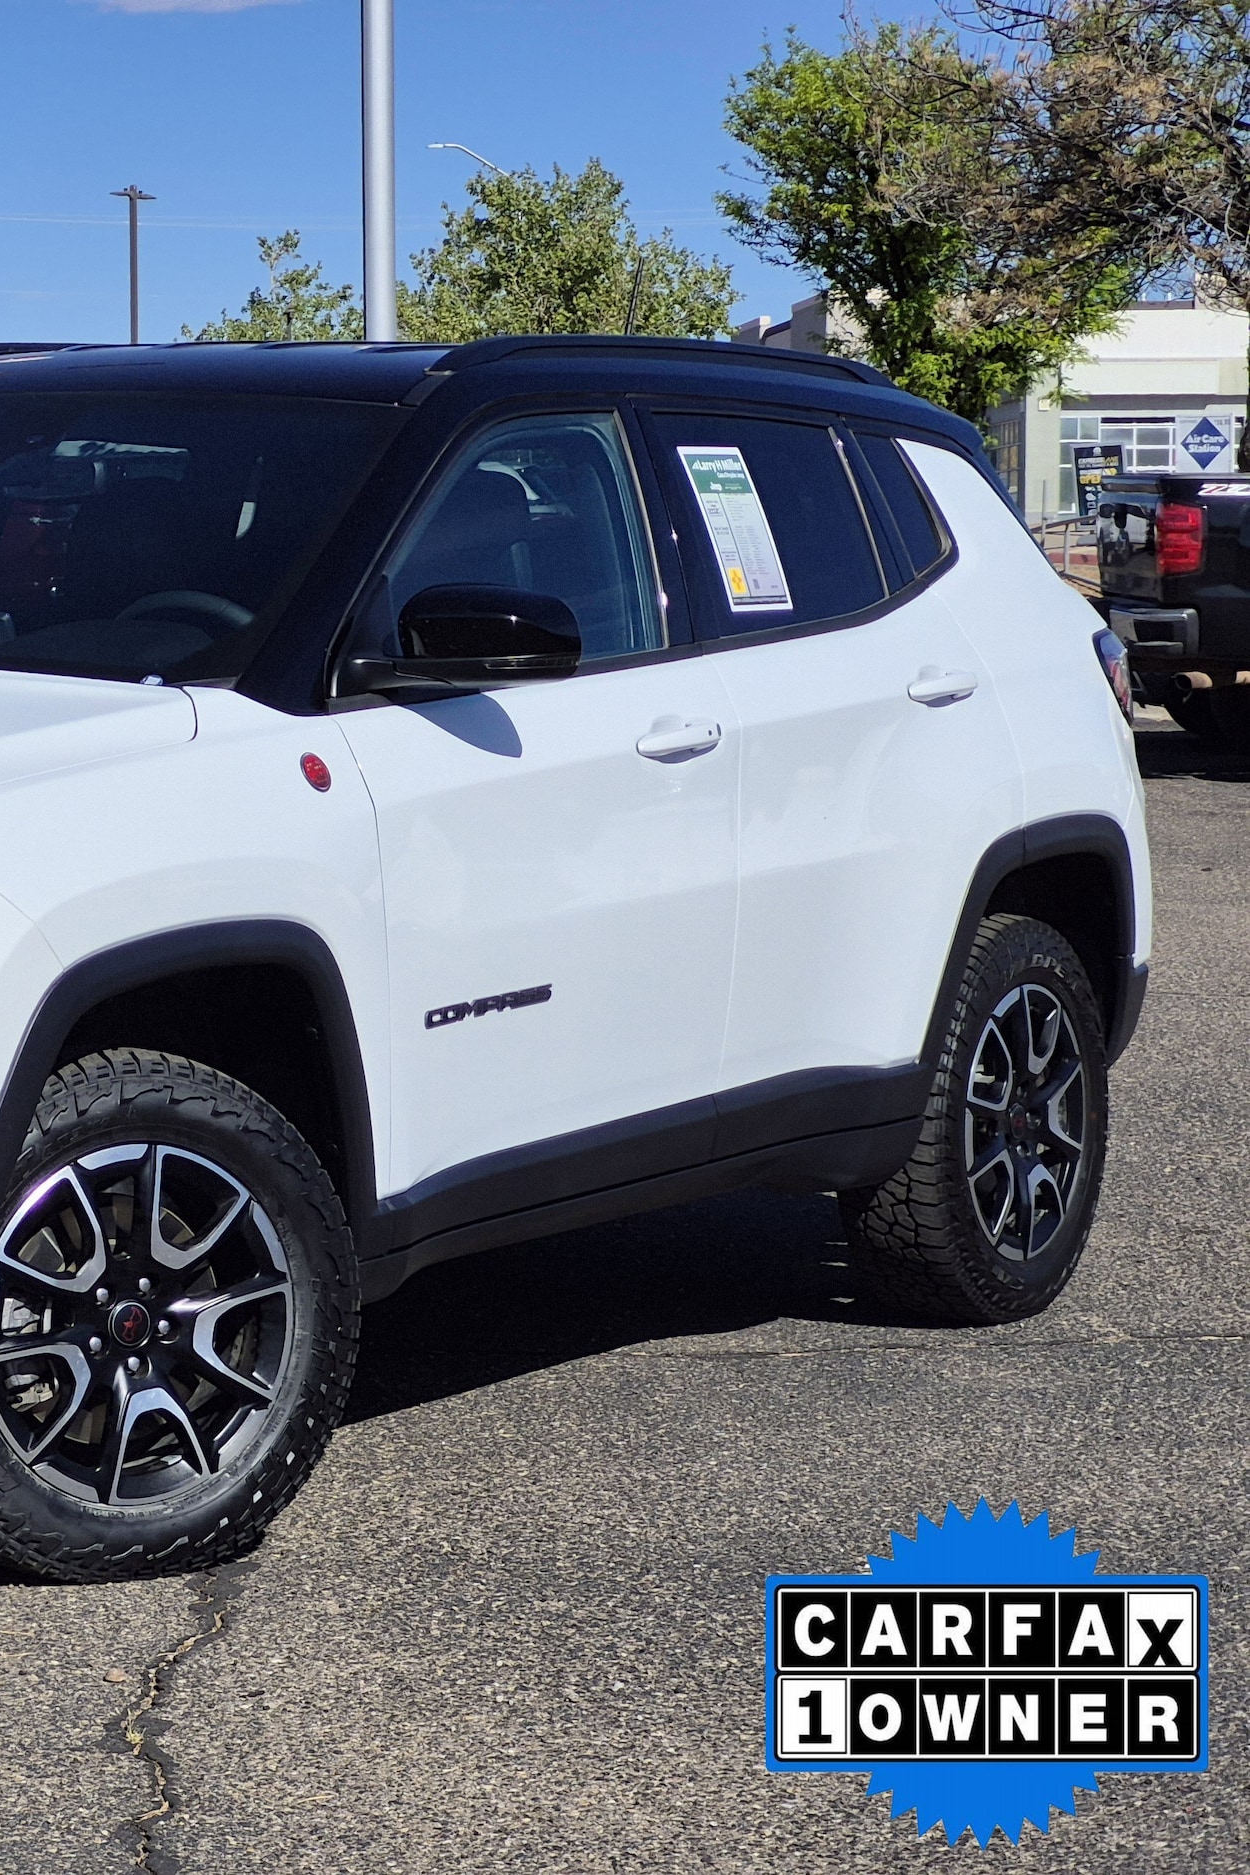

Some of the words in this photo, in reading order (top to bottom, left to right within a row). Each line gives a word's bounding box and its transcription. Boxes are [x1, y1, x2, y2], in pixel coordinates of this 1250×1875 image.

[1185, 434, 1200, 443] Air
[1202, 434, 1225, 443] Care
[1188, 444, 1221, 453] Station
[424, 983, 553, 1030] COMPASS
